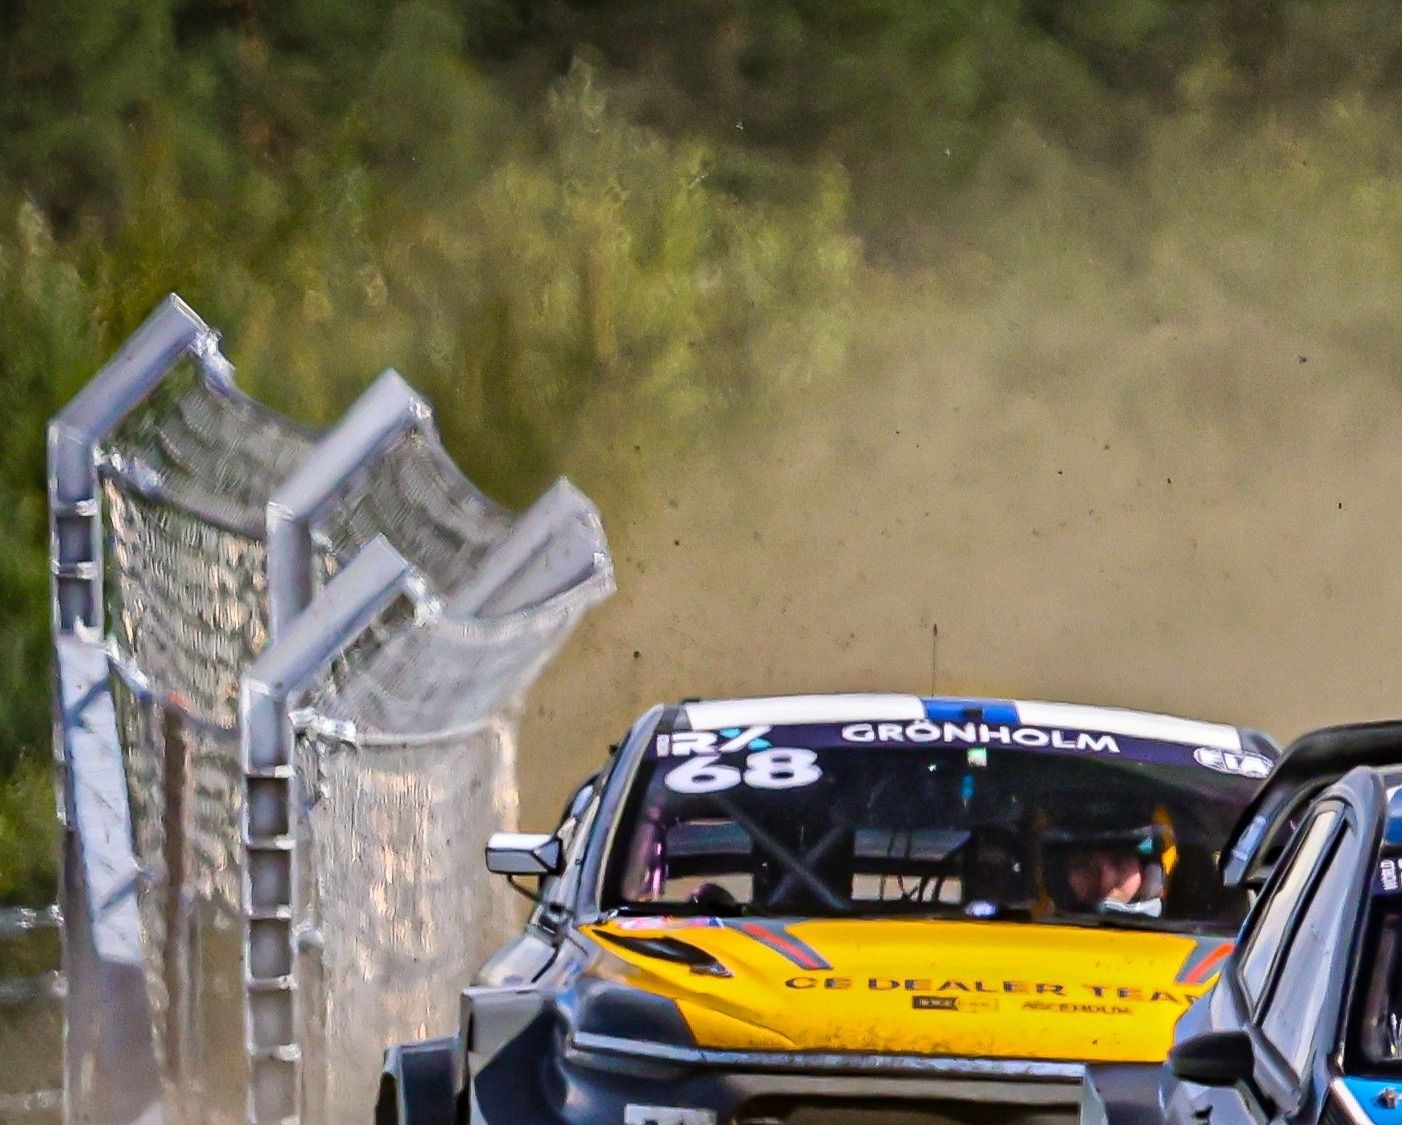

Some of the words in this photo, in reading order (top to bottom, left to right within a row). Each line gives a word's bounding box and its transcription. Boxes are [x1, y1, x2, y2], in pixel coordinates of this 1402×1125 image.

[841, 719, 1120, 754] GRÖNHOLM
[664, 747, 823, 794] 68
[867, 976, 1066, 997] DEALER
